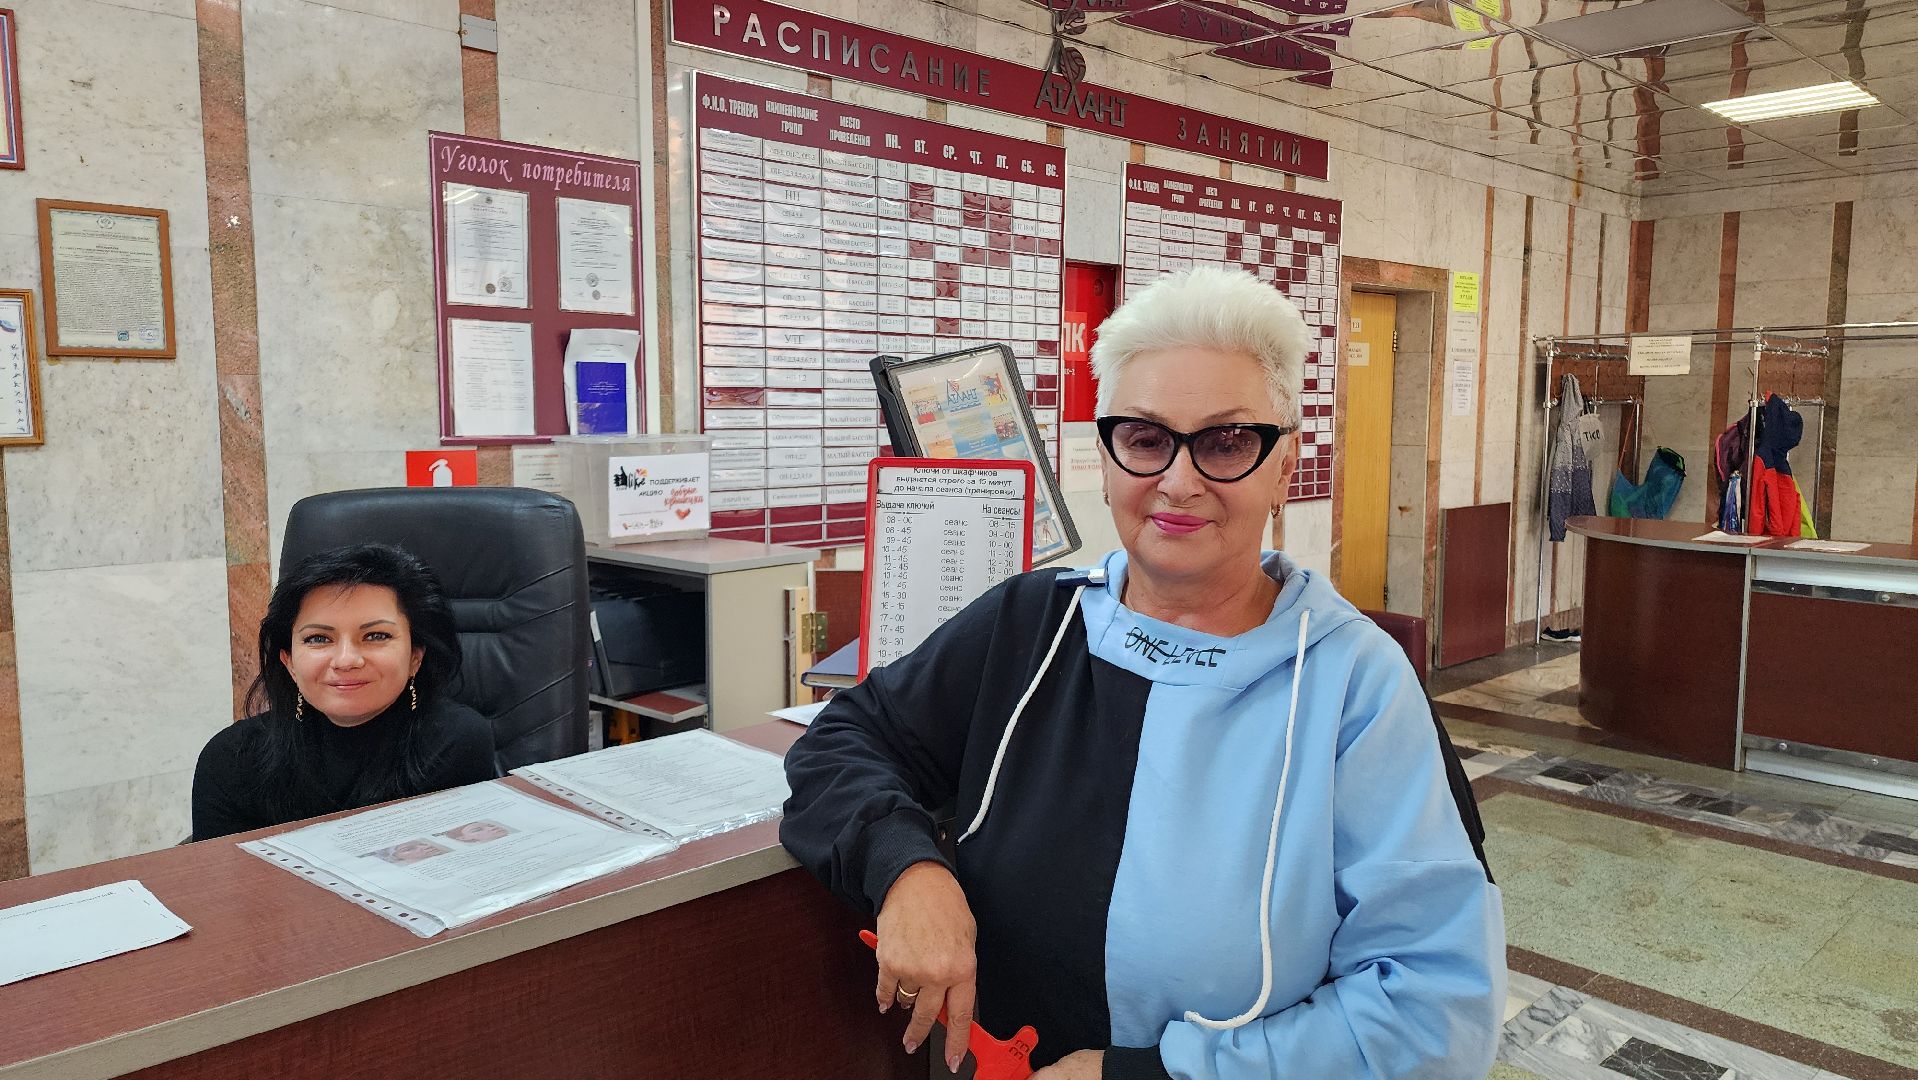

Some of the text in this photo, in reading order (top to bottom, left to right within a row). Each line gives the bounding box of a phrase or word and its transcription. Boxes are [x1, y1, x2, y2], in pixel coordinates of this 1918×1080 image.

[713, 4, 1301, 166] РАСПИСАНИЕ ЗАНЯТИЙ
[702, 93, 759, 119] Ф.И.О. ТРЕНЕРА
[765, 99, 819, 122] НАИМЕНОВАНИЕ
[1035, 77, 1128, 128] АТЛАНТ
[781, 120, 803, 136] ГРУПП
[839, 115, 861, 130] МЕСТО
[829, 128, 871, 148] ПРОВЕДЕНИЯ
[885, 133, 1059, 178] ПН. ВТ. СР. ЧТ. ПТ. СБ. ВС.
[441, 145, 631, 192] Уголок потребителя
[1248, 200, 1258, 212] ВТ.
[1265, 203, 1275, 215] СР.
[1282, 206, 1291, 218] ЧТ.
[1297, 208, 1307, 220] ПТ.
[1313, 210, 1322, 222] СБ.
[947, 386, 978, 406] АТЛАНТ
[649, 476, 701, 486] ПОДДЕРЖИВАЕТ
[913, 467, 940, 475] Ключи
[952, 468, 998, 478] шкафчиков
[893, 485, 905, 493] до
[935, 486, 963, 494] сеанса
[988, 480, 1013, 488] минут
[982, 503, 1021, 516] На сеансы
[900, 526, 912, 534] 45
[879, 624, 905, 634] 17 45
